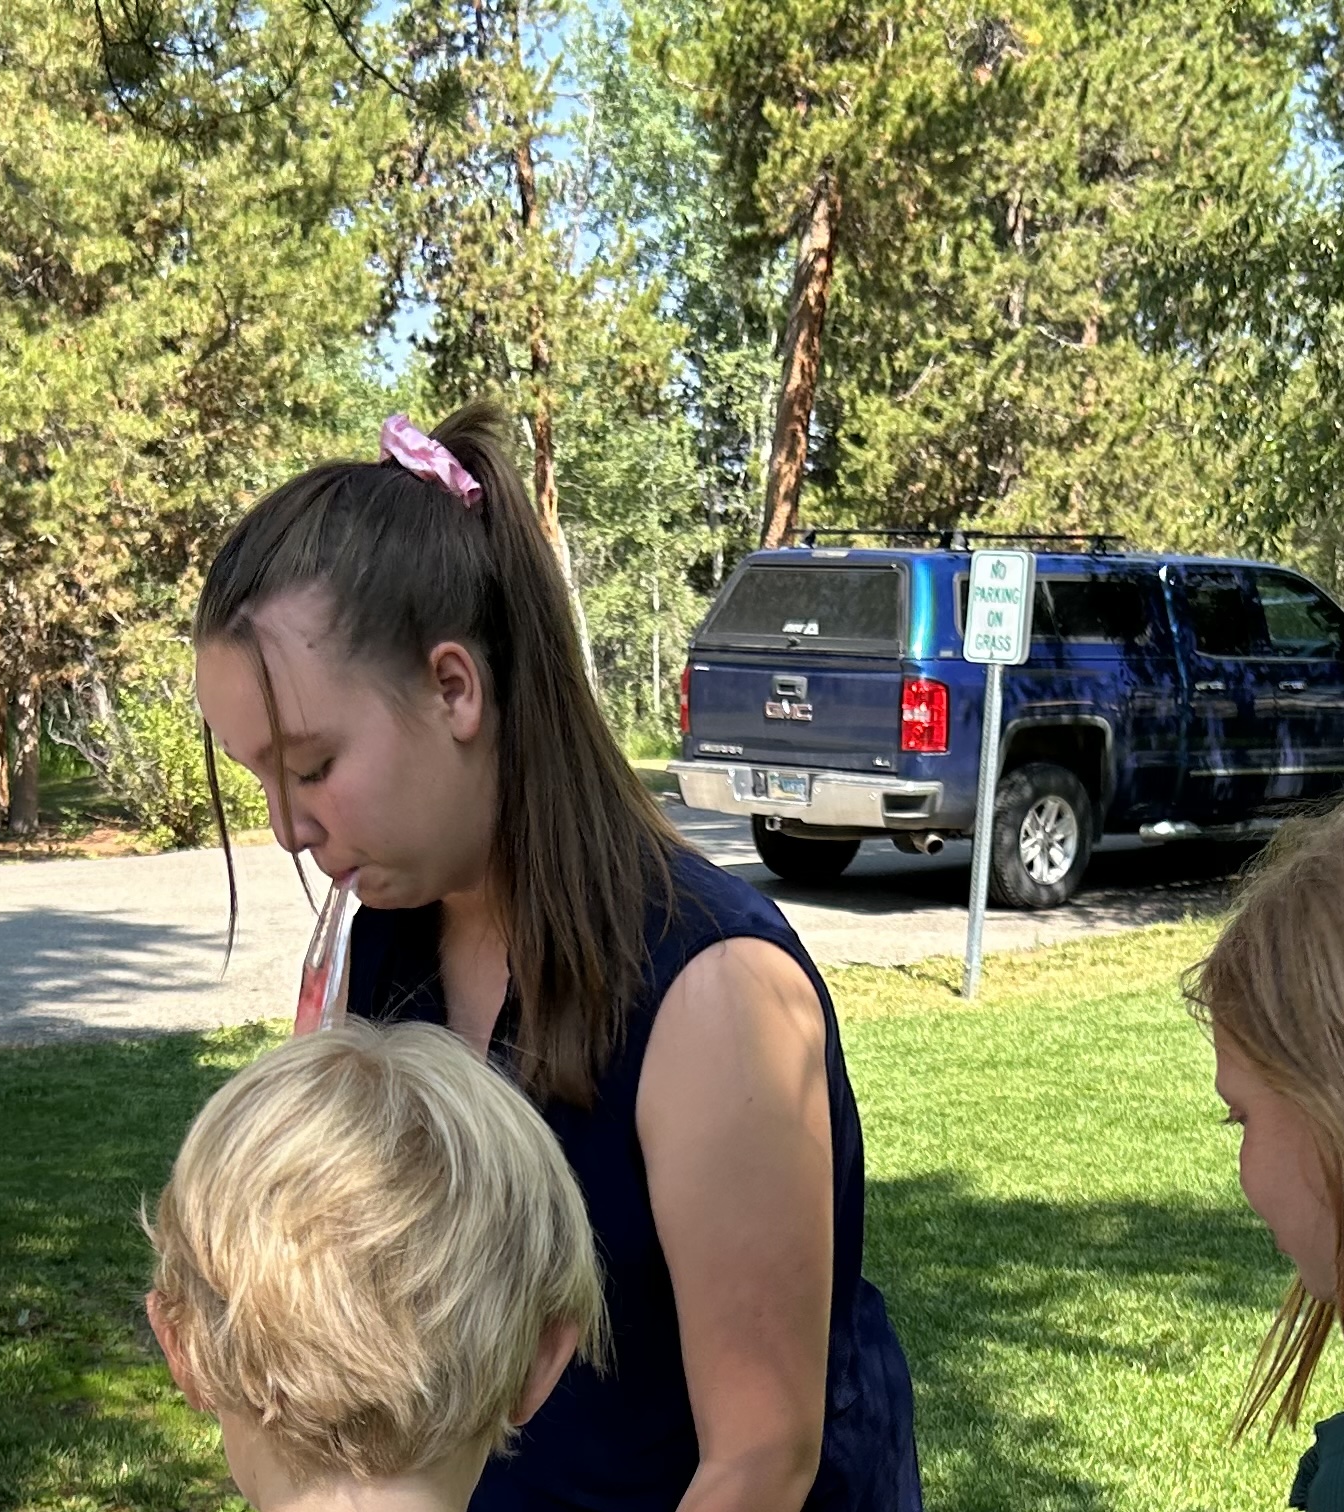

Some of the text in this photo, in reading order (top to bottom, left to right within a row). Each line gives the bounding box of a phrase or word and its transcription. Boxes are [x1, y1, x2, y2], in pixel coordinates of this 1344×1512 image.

[990, 563, 1007, 580] NO
[973, 586, 1021, 604] PARKING
[987, 610, 1004, 628] ON
[975, 633, 1012, 652] GRASS
[766, 701, 813, 721] GMC
